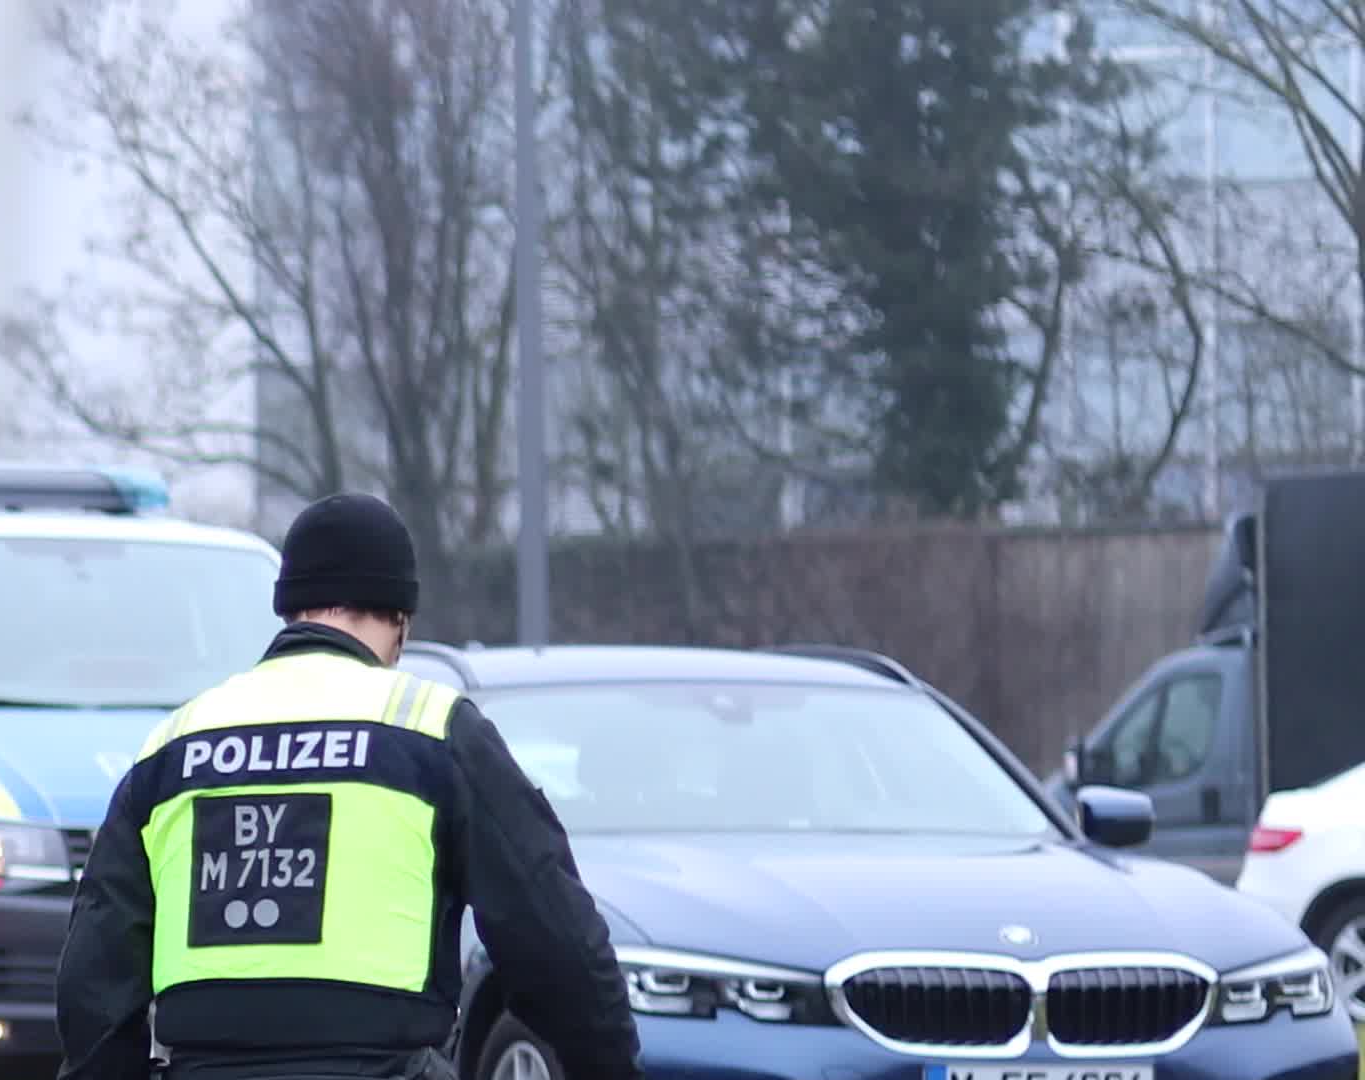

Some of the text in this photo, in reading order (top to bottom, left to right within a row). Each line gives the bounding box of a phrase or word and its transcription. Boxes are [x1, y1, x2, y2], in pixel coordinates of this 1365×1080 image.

[182, 730, 370, 779] POLIZEI
[234, 803, 288, 846] BY
[200, 848, 316, 891] M 7132
